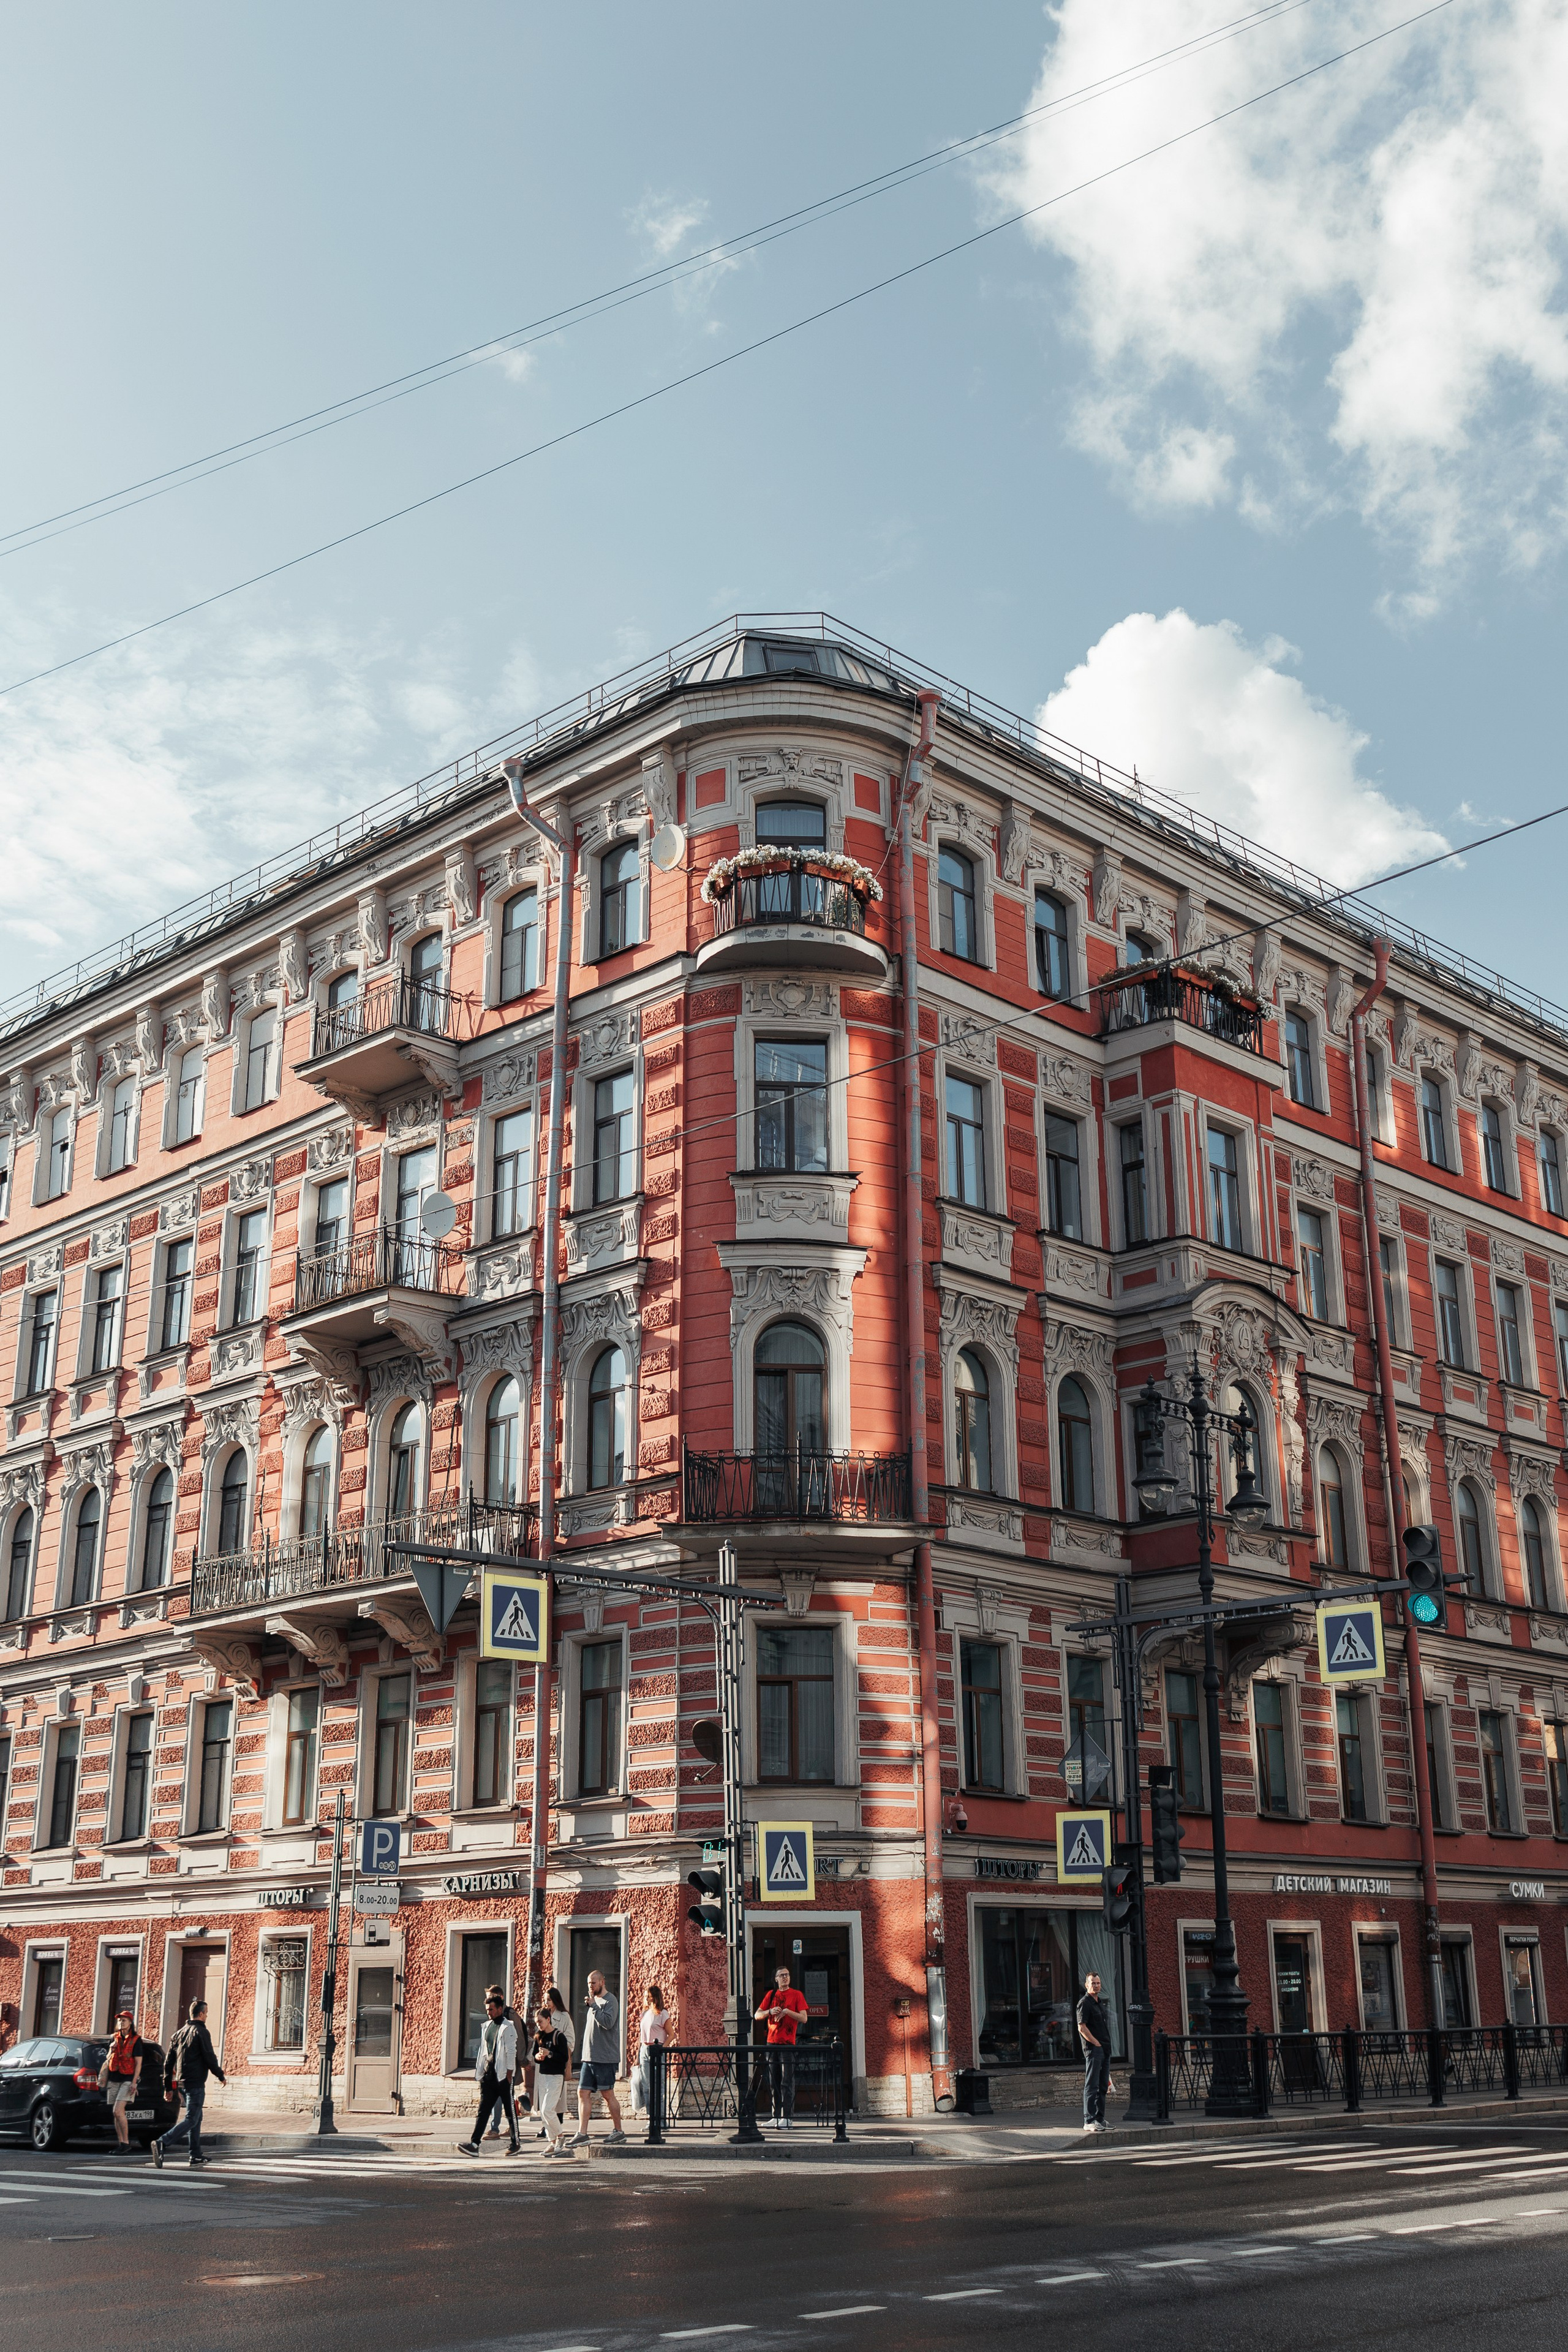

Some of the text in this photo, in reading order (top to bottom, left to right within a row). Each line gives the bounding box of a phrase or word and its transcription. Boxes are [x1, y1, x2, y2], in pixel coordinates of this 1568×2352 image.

[372, 1828, 393, 1868] P
[982, 1858, 1041, 1879] ШТОРЫ
[440, 1872, 514, 1894] КАРНИЗЫ
[1276, 1875, 1391, 1894] ДЕТСКИЙ МАГАЗИН
[1512, 1882, 1545, 1898] СУМКИ
[257, 1888, 305, 1905] ШТОРЫ
[359, 1894, 398, 1905] 8.00-20.00
